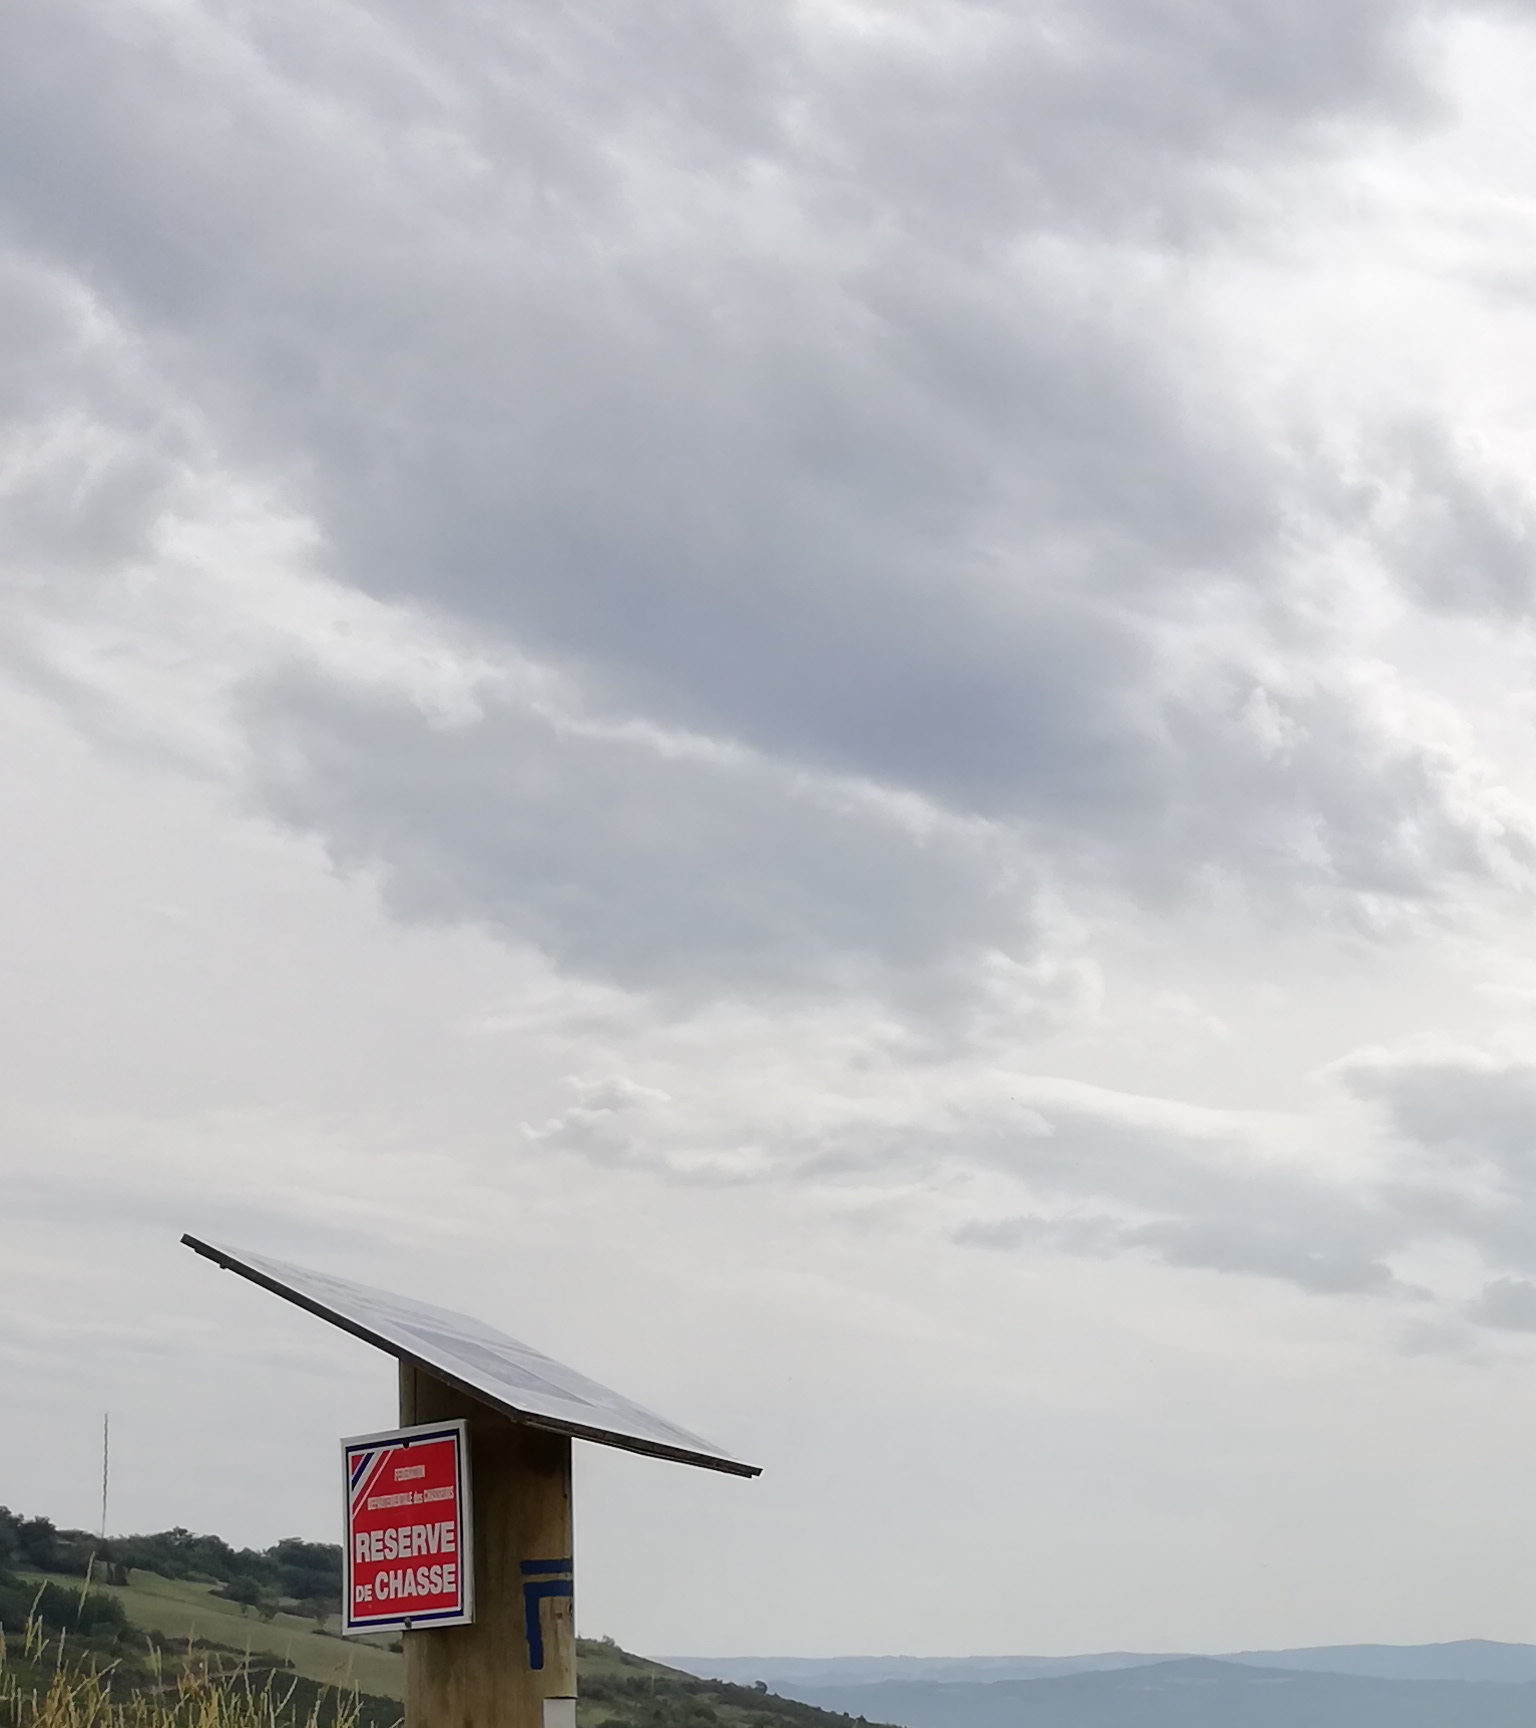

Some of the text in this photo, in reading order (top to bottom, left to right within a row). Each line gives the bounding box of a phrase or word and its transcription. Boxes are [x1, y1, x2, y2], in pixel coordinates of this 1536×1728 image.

[355, 1521, 456, 1563] RESERVE
[356, 1563, 456, 1603] DE CHASSE
